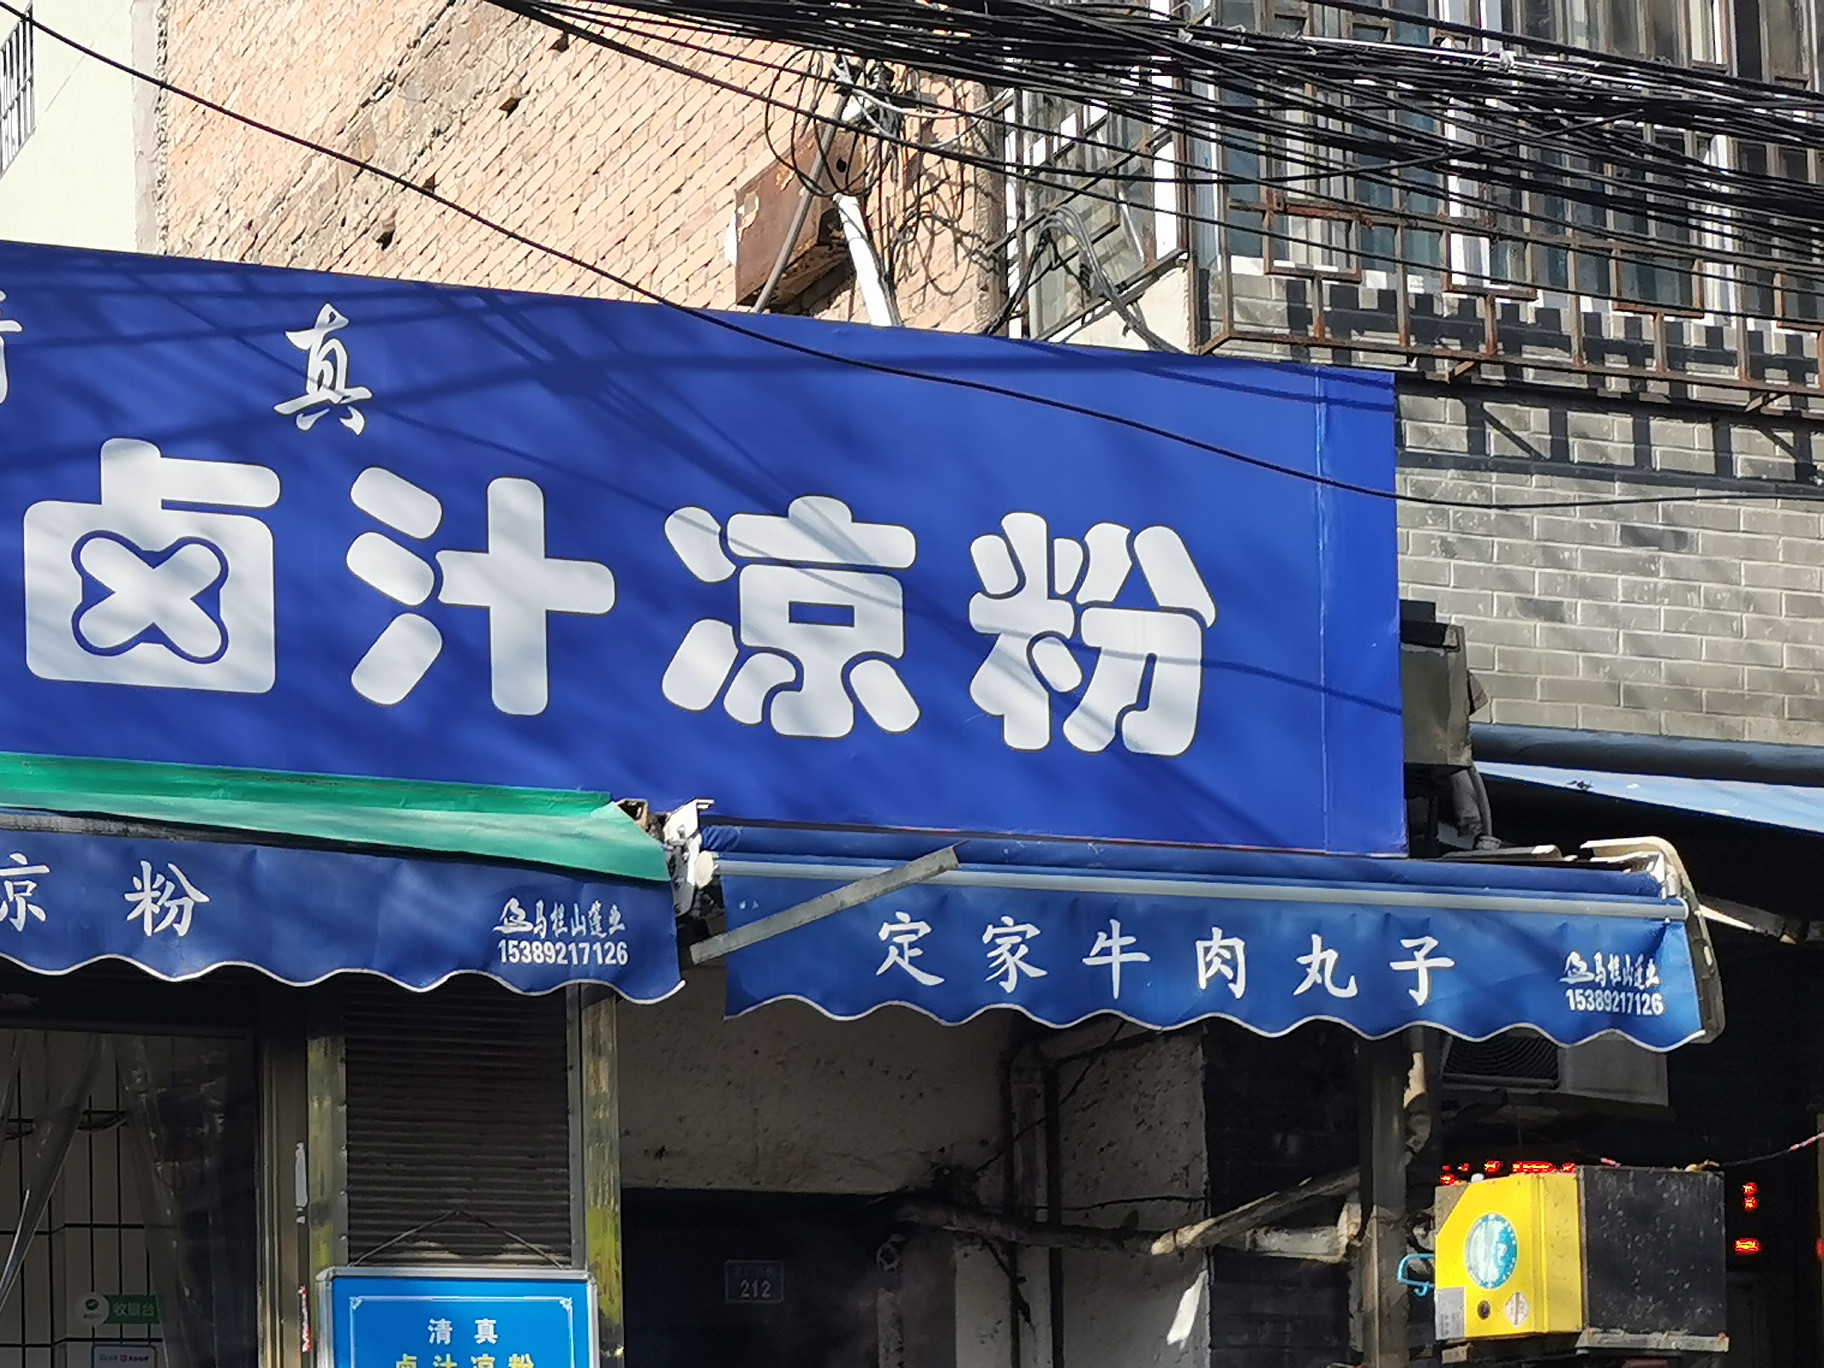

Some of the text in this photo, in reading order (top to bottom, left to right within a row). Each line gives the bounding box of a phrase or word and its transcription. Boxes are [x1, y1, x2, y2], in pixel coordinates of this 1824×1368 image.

[499, 938, 629, 966] 15389217126
[876, 911, 1456, 1006] 定家牛肉丸子
[1566, 987, 1667, 1016] 15389217126
[740, 1279, 772, 1298] 212
[428, 1318, 499, 1345] 清真
